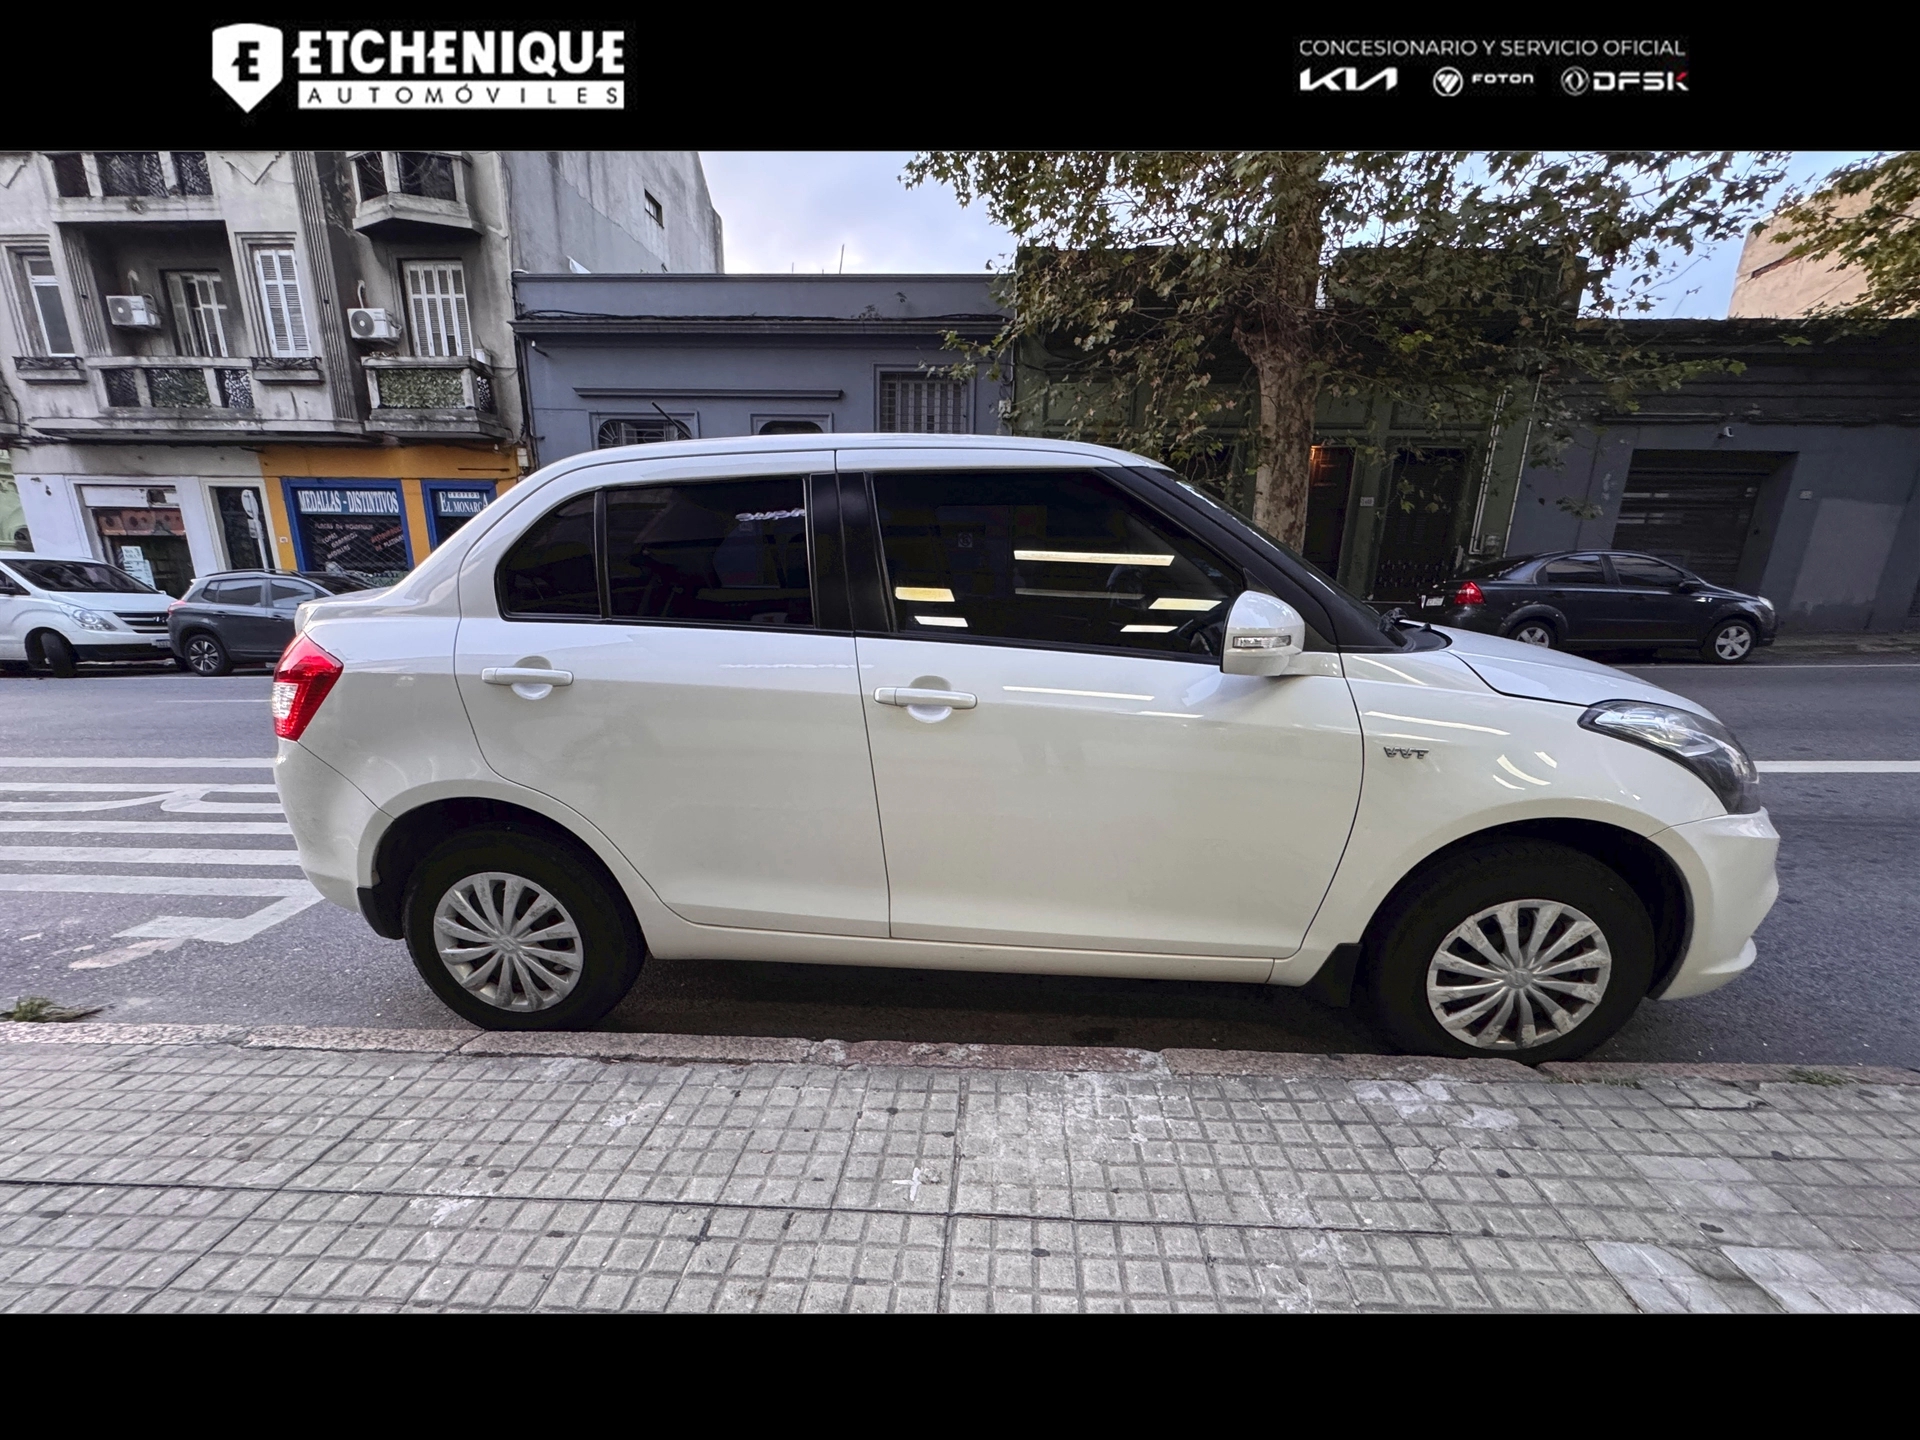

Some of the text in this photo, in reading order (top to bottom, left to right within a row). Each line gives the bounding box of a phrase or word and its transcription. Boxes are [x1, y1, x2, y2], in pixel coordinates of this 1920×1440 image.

[297, 490, 342, 512] MEDALLAS
[346, 490, 399, 513] DISTINTIVOS
[439, 491, 489, 513] EL MONARCA
[1383, 746, 1430, 760] VVT
